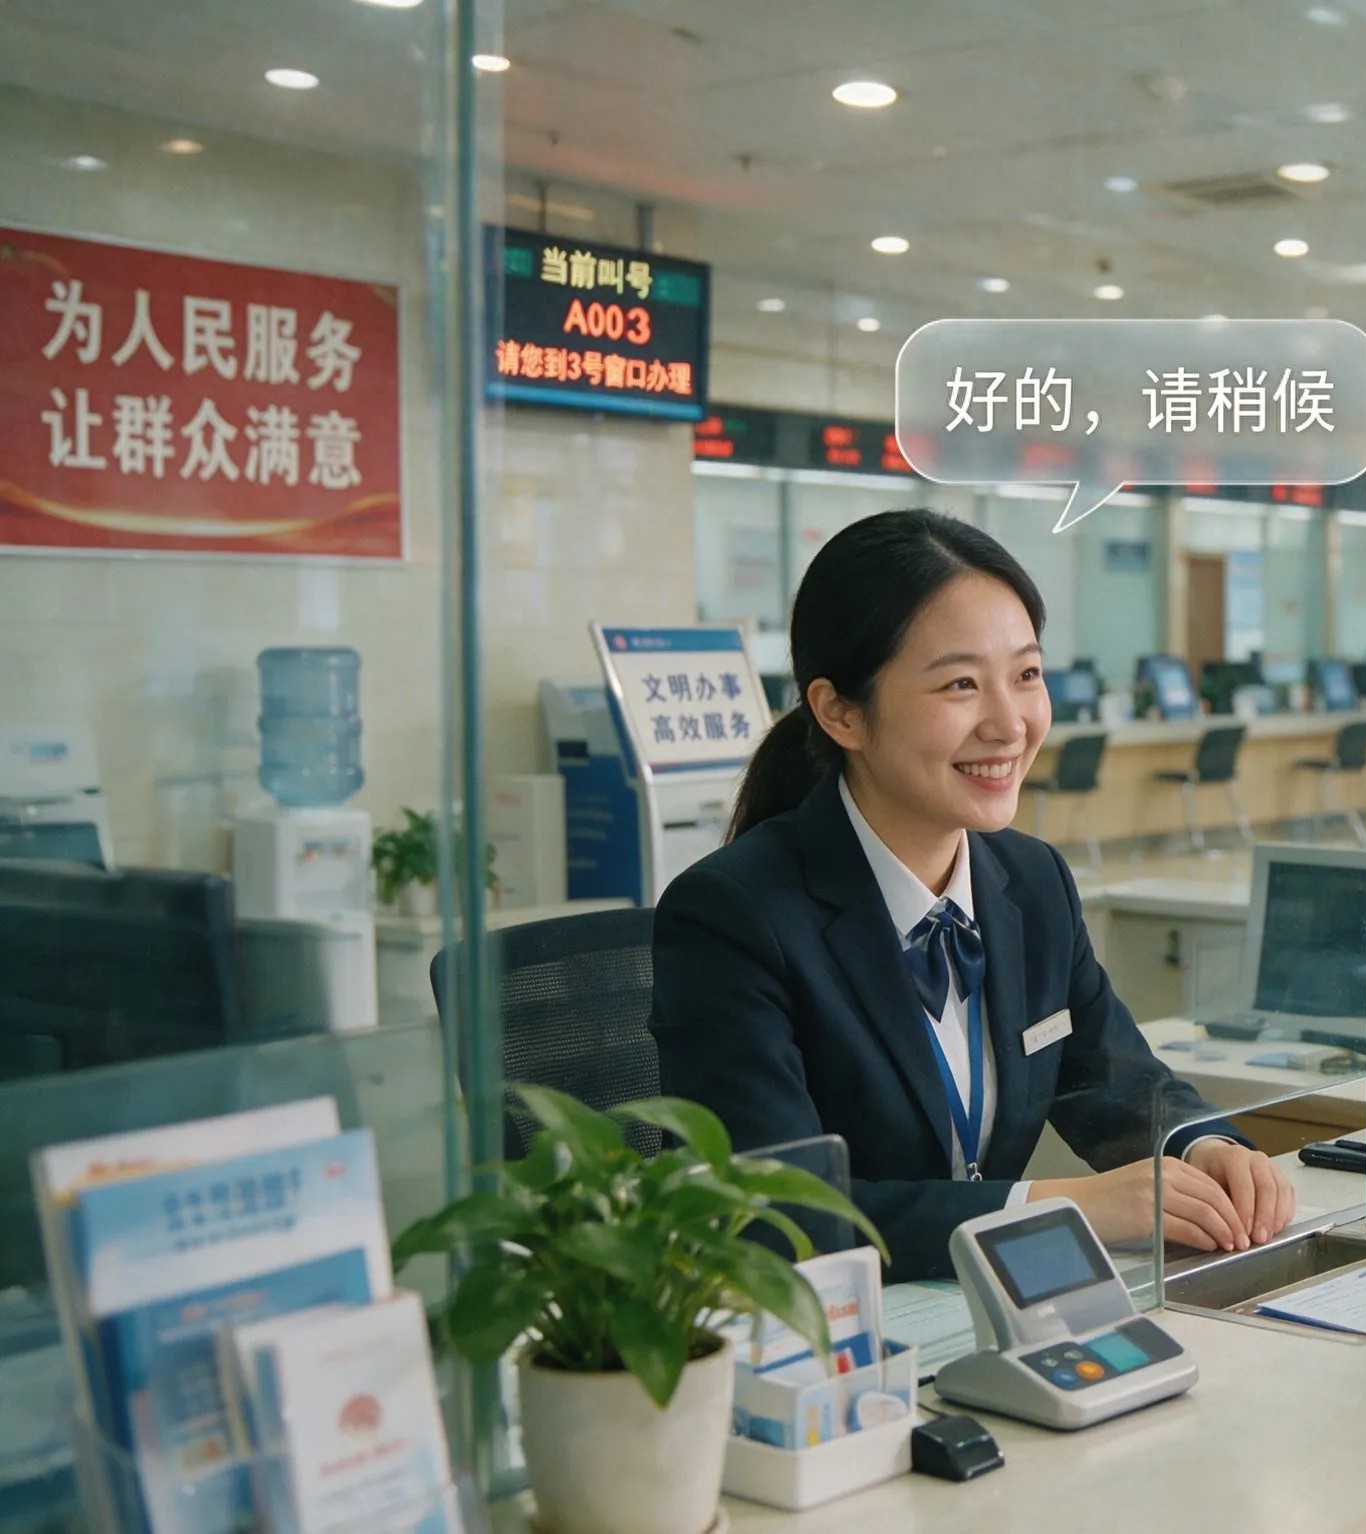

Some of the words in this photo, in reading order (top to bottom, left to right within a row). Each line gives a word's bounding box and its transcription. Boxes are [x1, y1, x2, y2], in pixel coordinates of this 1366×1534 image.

[541, 247, 653, 299] 当前叫号
[42, 280, 361, 392] 为人民服务
[563, 299, 651, 344] A003
[496, 339, 692, 395] 请您到3号窗口办理
[41, 387, 362, 489] 让群众满意
[641, 672, 741, 702] 文明办事
[651, 710, 750, 743] 高效服务
